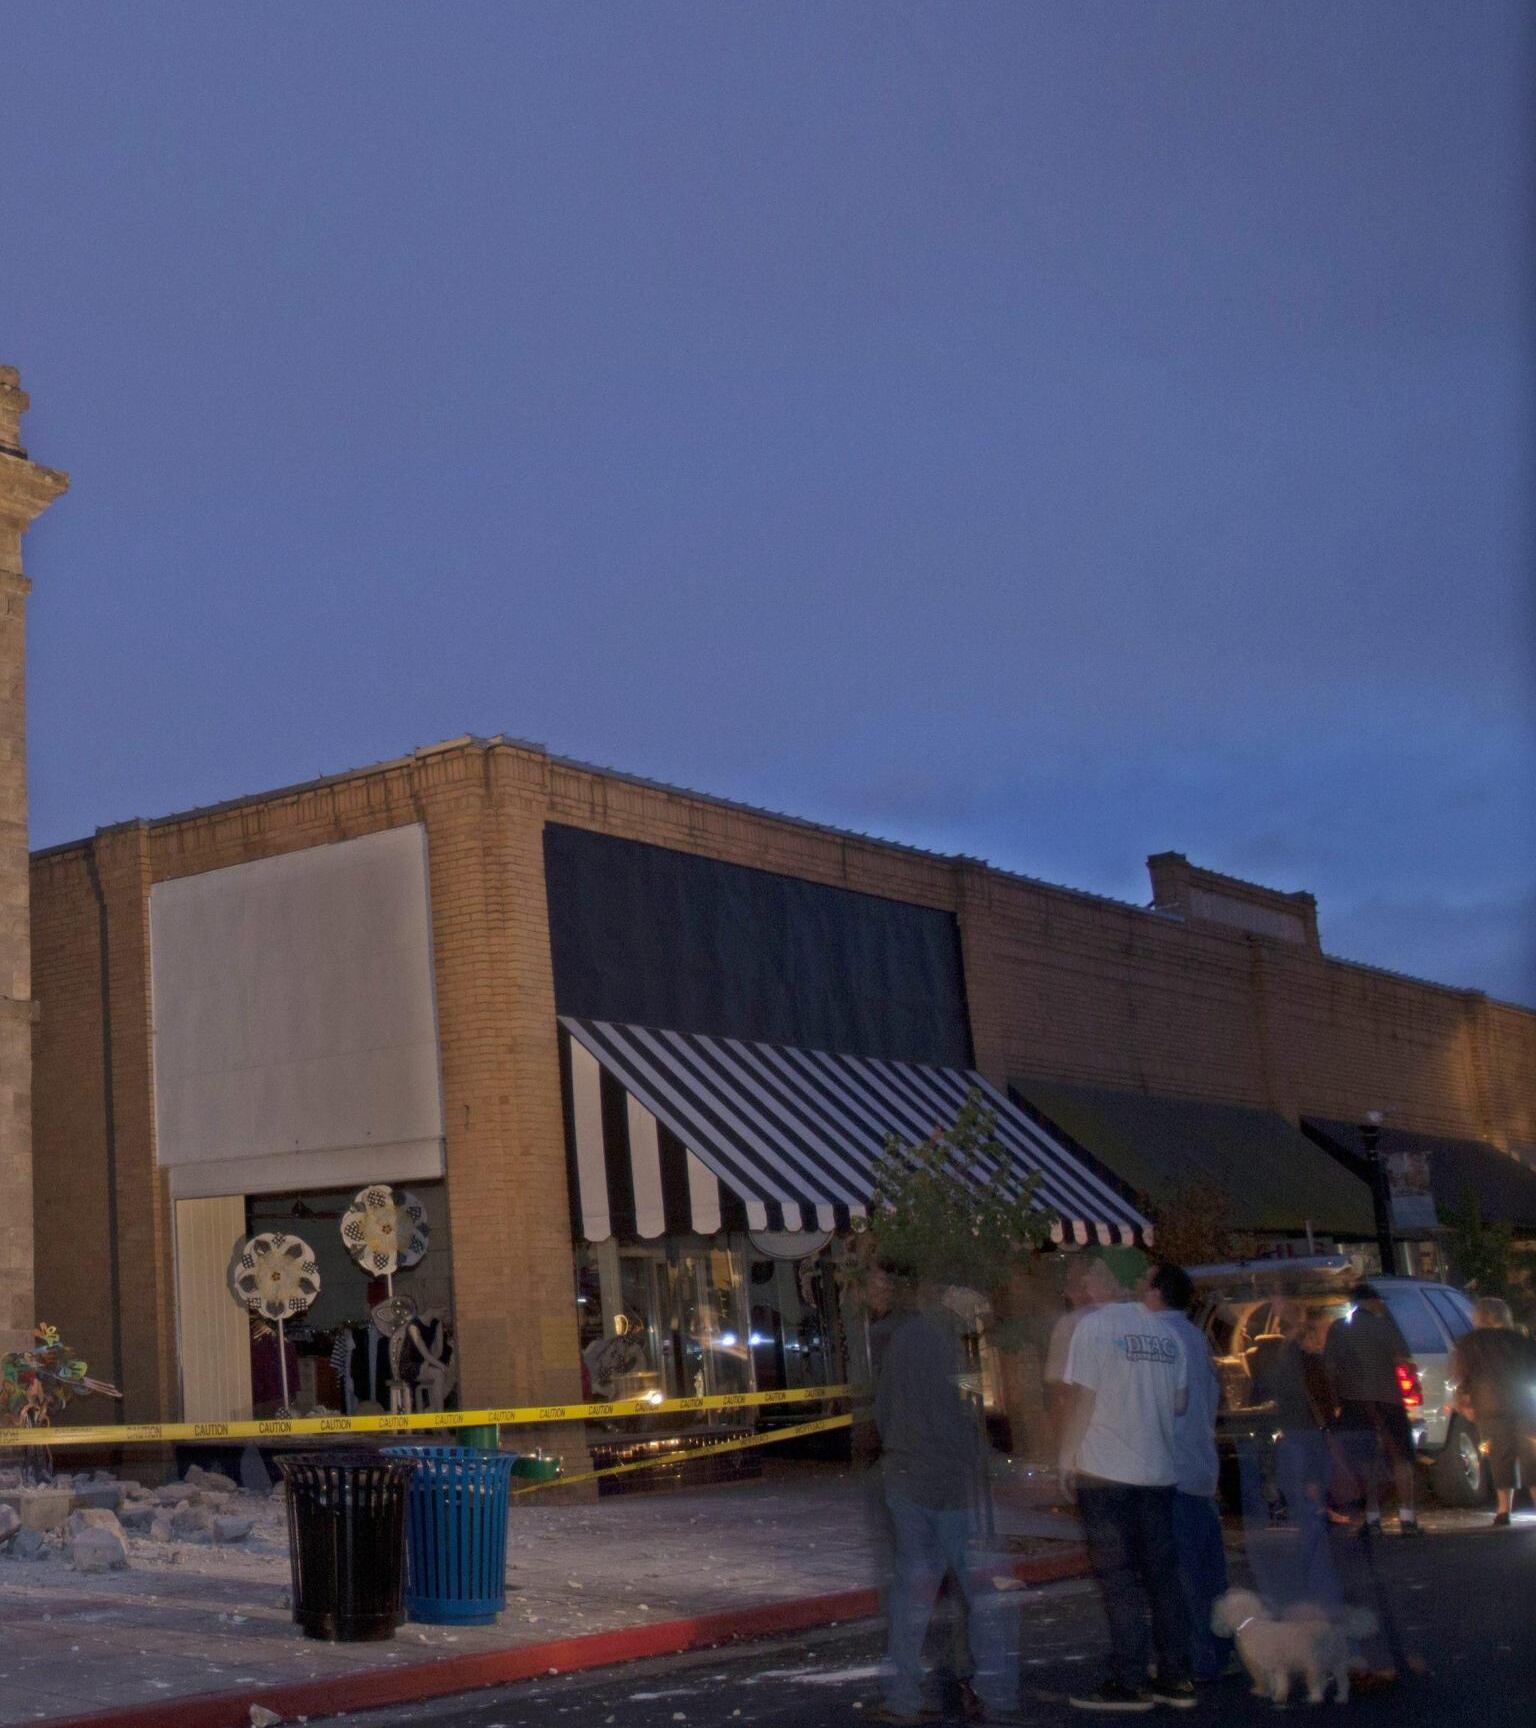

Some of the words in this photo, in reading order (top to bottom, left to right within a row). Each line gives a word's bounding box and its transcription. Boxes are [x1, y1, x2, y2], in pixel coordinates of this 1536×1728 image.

[194, 1423, 229, 1437] CAUTION
[259, 1422, 292, 1433] CAUTION
[320, 1420, 352, 1431] CAUTION
[379, 1417, 409, 1428] CAUTION
[435, 1414, 464, 1425] CAUTION
[488, 1411, 515, 1422] CAUTION
[540, 1407, 565, 1419] CAUTION
[588, 1405, 613, 1415] CAUTION
[680, 1399, 703, 1409] CAUTION
[723, 1395, 746, 1405] CAUTION
[765, 1391, 787, 1401] CAUTION
